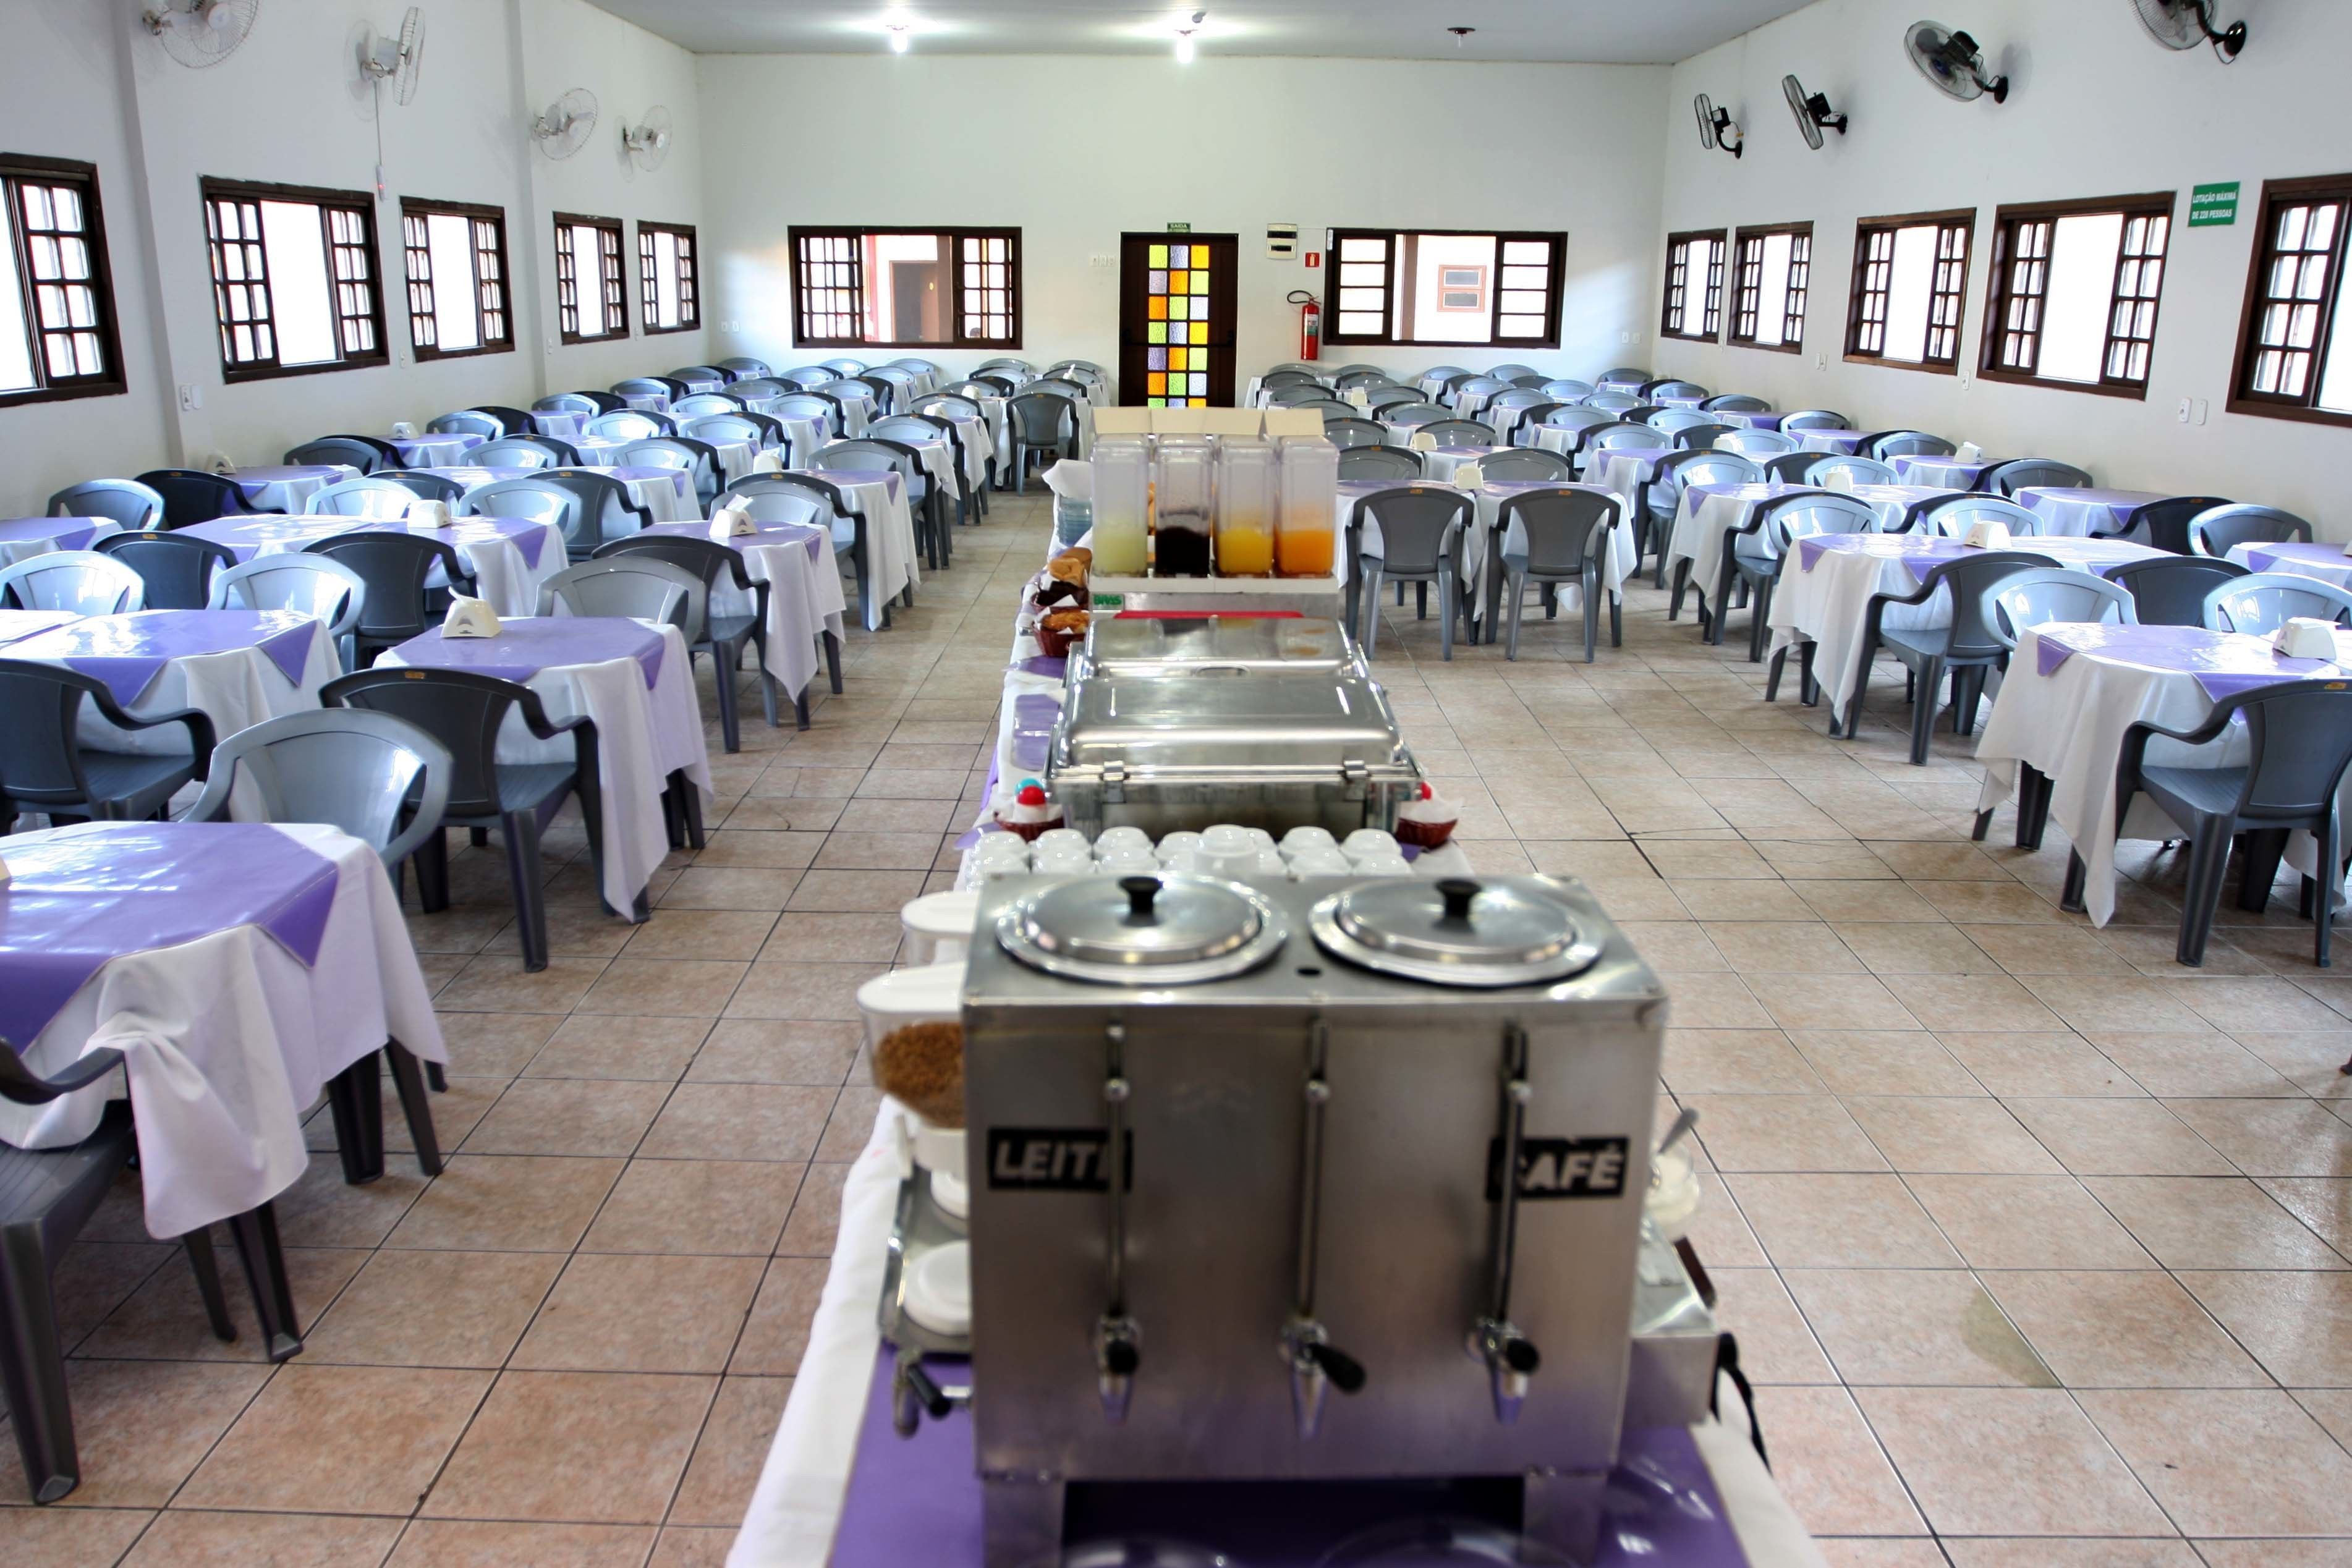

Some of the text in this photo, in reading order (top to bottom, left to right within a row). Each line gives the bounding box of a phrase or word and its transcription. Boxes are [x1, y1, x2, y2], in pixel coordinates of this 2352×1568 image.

[2193, 192, 2215, 204] LOTAÇÃO
[2191, 211, 2199, 219] DE
[2209, 209, 2232, 218] PESSOAS
